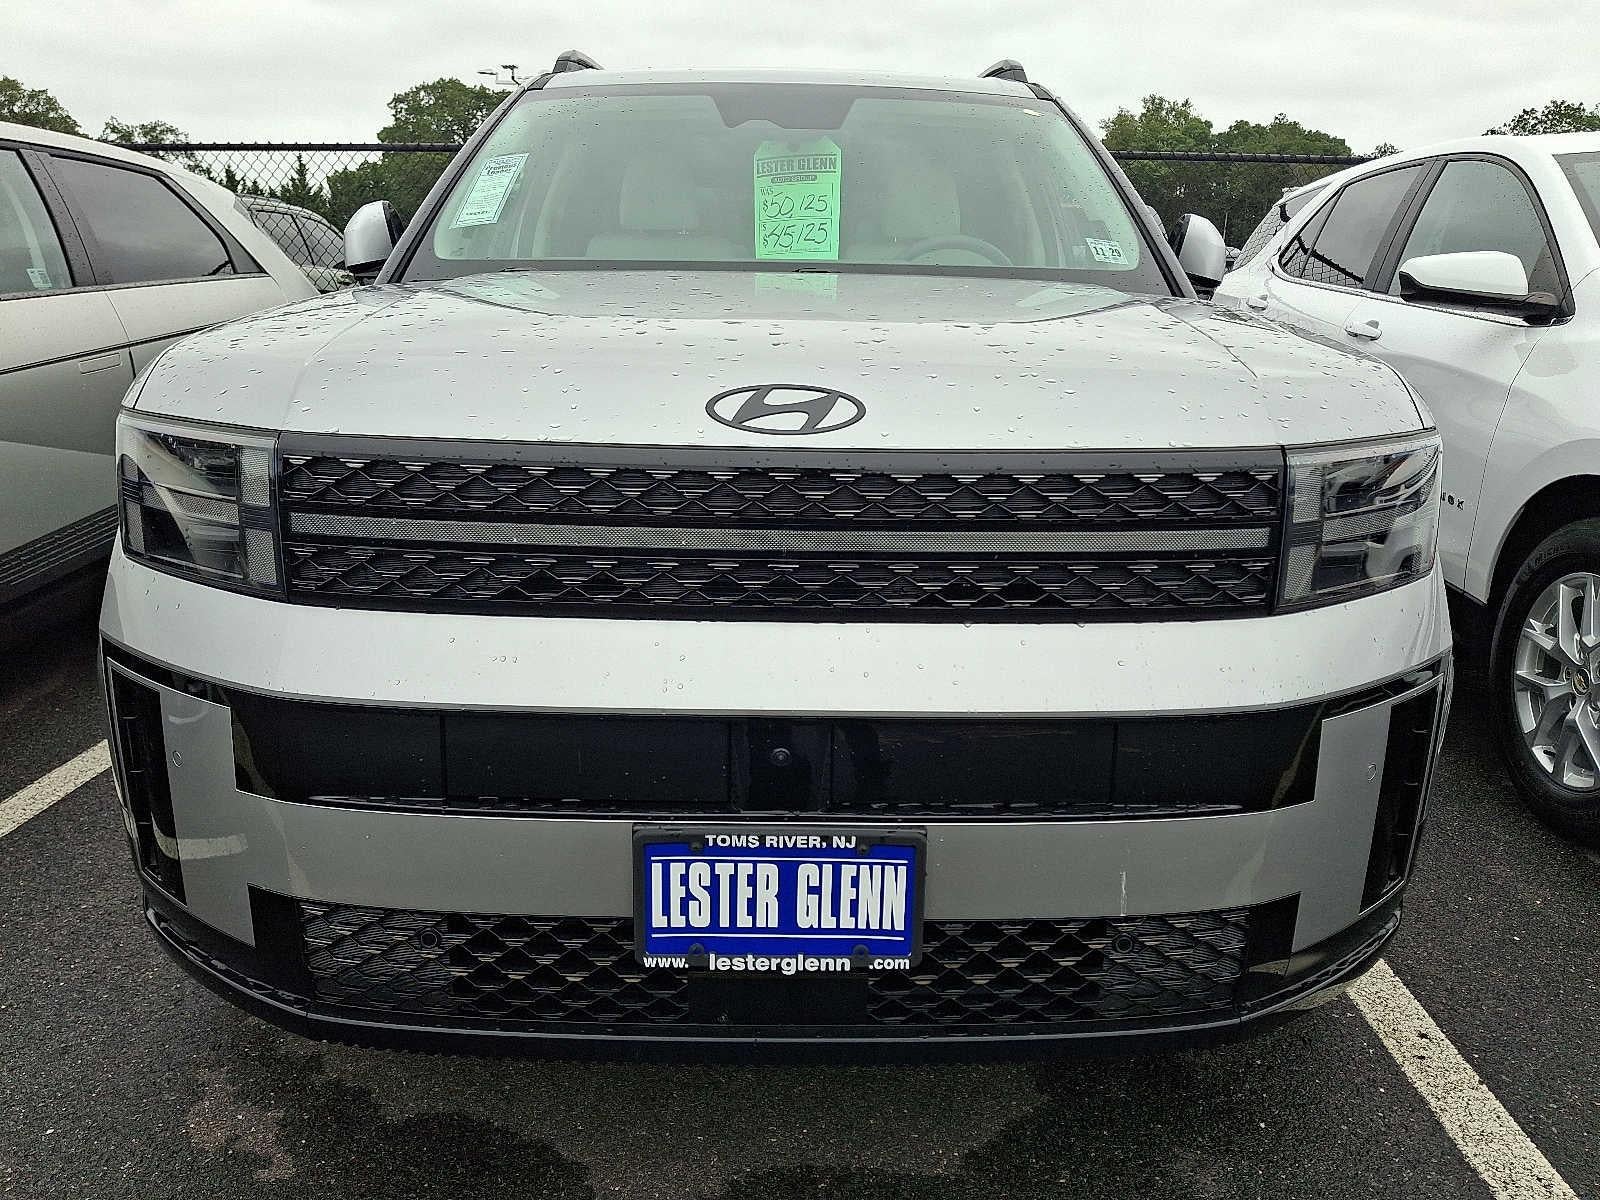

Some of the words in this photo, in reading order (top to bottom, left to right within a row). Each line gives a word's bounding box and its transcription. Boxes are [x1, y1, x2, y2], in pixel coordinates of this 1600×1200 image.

[757, 160, 795, 174] LESTER
[798, 157, 837, 171] GLENN
[705, 835, 760, 849] TOMS
[765, 835, 827, 849] RIVER,
[832, 836, 857, 849] NJ
[651, 861, 780, 929] LESTER
[796, 863, 908, 931] GLENN
[643, 956, 690, 969] www.
[709, 953, 851, 976] lesterglenn
[868, 957, 911, 971] .com
